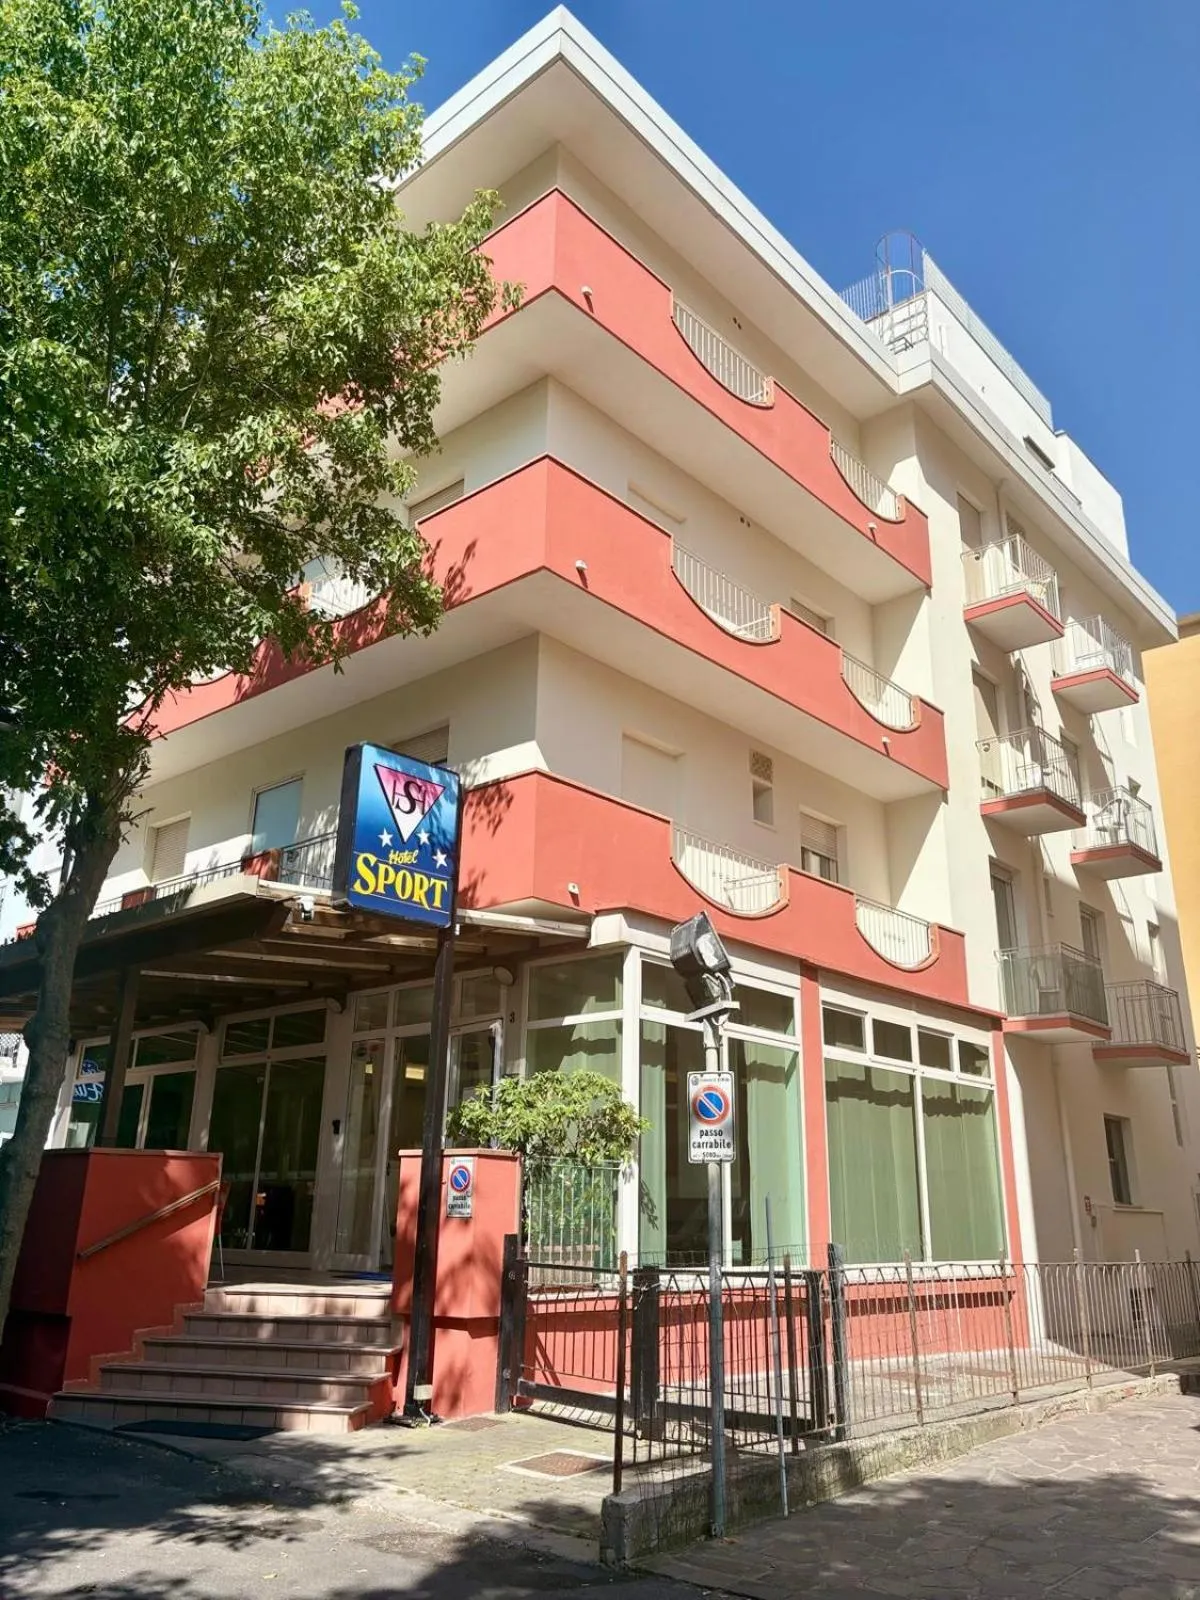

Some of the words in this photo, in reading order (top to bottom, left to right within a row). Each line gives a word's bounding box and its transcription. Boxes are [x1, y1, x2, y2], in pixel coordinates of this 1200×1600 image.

[388, 849, 419, 865] Hotel
[353, 852, 448, 911] SPORT
[699, 1129, 723, 1139] passo
[692, 1139, 732, 1149] carrabile
